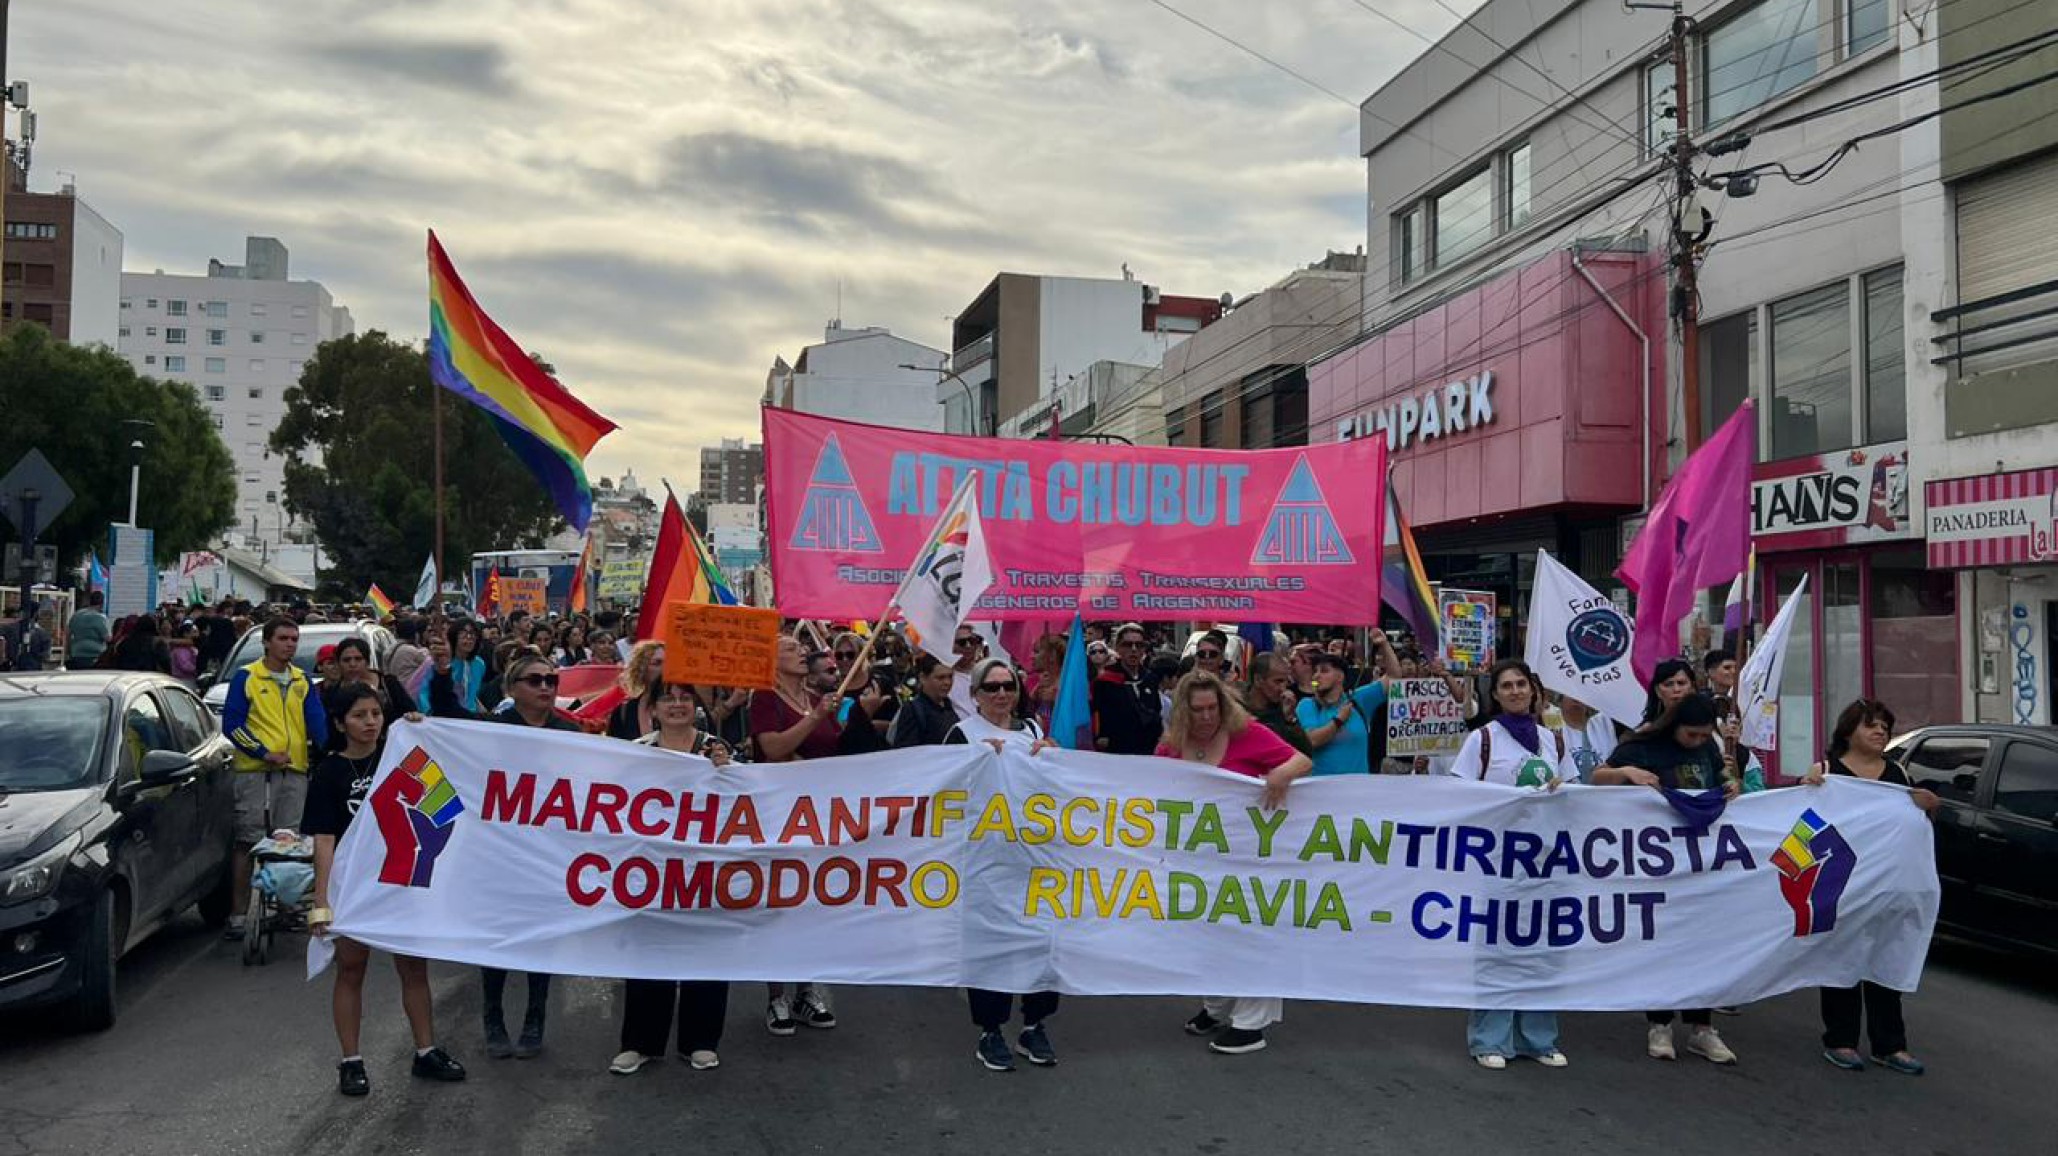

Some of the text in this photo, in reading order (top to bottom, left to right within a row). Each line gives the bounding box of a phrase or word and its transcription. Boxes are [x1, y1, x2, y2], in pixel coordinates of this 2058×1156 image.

[888, 452, 1249, 527] ATTTA CHUBUT
[1932, 508, 2028, 534] PANADERIA
[1132, 592, 1257, 611] ARGENTINA
[1405, 680, 1450, 698] FASCIS
[480, 769, 1757, 879] MARCHA ANTIFASCISTA Y ANTIRRACISTA
[565, 852, 1667, 948] COMODORO RIVADAVIA - CHUBUT
